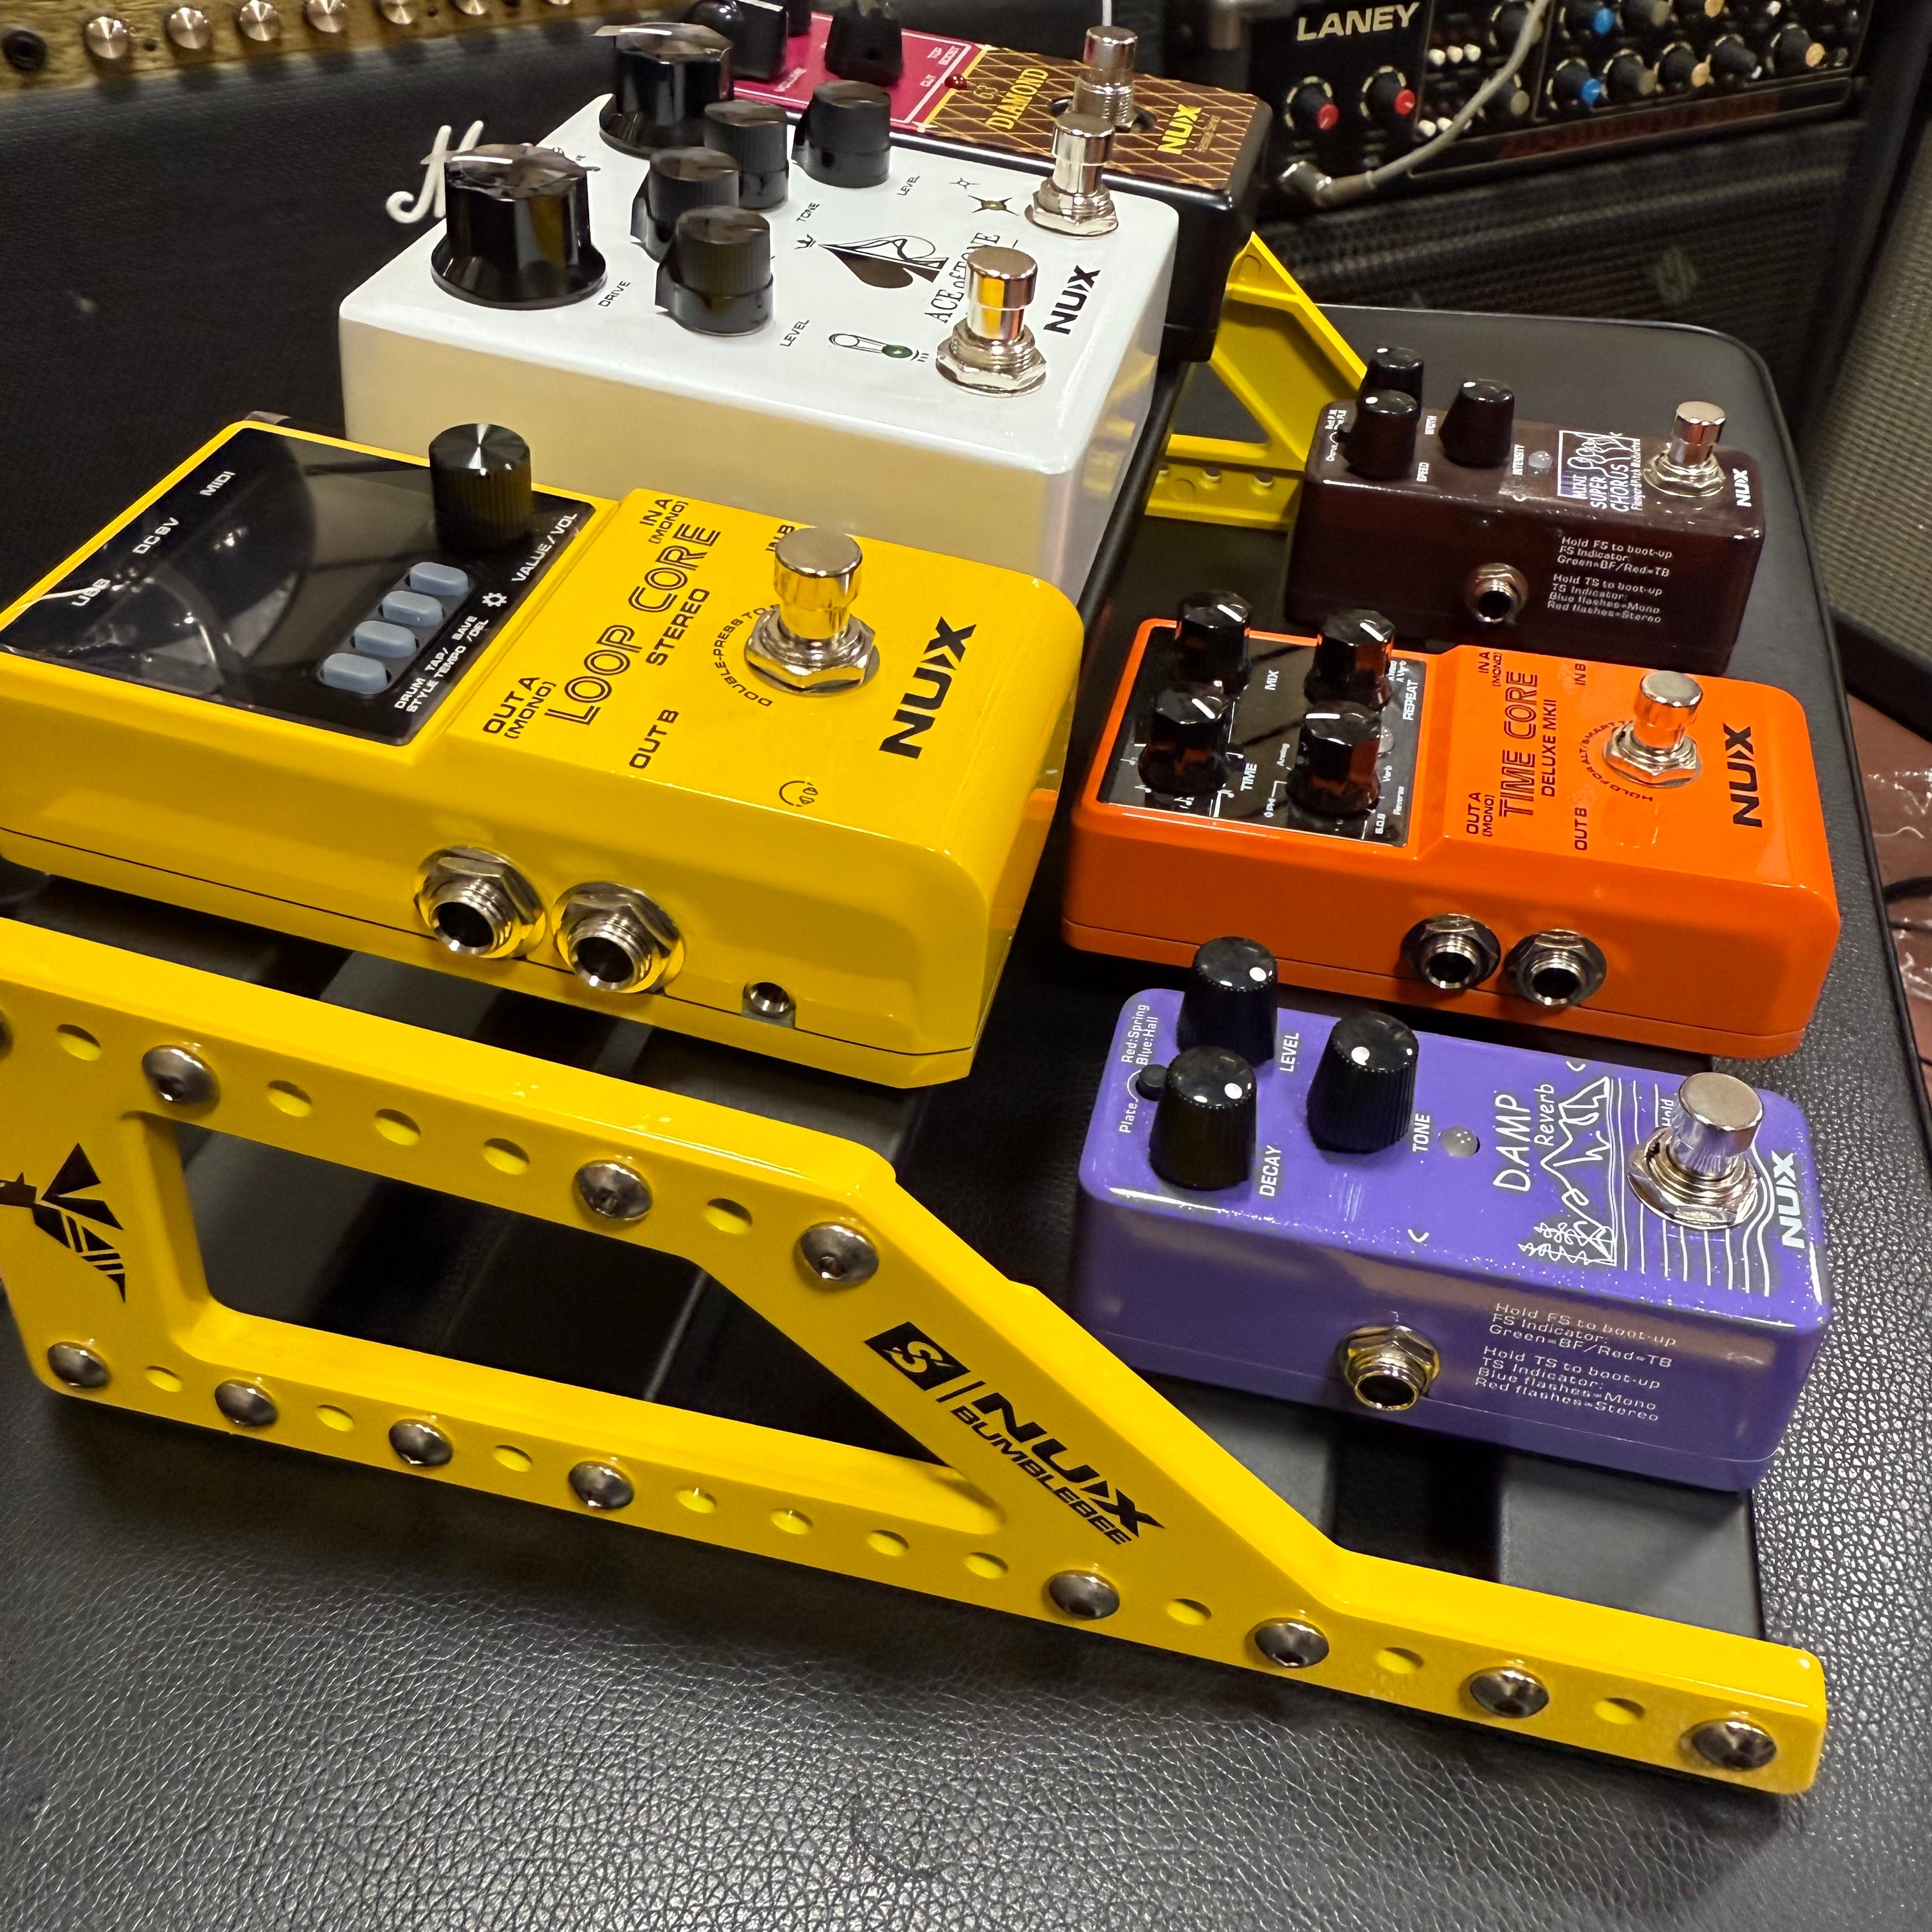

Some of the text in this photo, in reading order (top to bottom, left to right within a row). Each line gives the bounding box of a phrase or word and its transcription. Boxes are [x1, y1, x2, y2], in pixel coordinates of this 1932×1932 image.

[1296, 2, 1420, 41] LANEY
[985, 68, 1048, 129] DIAMOND
[1158, 103, 1202, 155] NUX
[897, 175, 920, 196] LEVEL
[796, 202, 820, 223] TONE
[597, 280, 631, 307] DRIVE
[924, 289, 965, 323] ACE
[1043, 264, 1101, 335] NUX
[780, 319, 810, 347] LEVEL
[199, 471, 236, 496] MIDI
[1572, 475, 1588, 500] MINI
[1590, 477, 1607, 509] SUPER
[1609, 464, 1629, 512] CHORUS
[1733, 468, 1752, 507] NUX
[639, 499, 673, 526] IN A
[648, 500, 689, 544] (MONO)
[132, 535, 160, 554] DC
[511, 543, 552, 581] VALUE
[550, 513, 578, 534] VOL
[1561, 536, 1589, 548] Hold
[1611, 544, 1624, 552] to
[71, 578, 111, 606] USB
[1549, 592, 1574, 602] Blue
[1552, 583, 1567, 592] TS
[1553, 573, 1581, 585] Hold
[1584, 577, 1599, 586] TS
[1602, 581, 1614, 589] to
[544, 523, 721, 726] LOOP CORE
[1547, 601, 1570, 611] Red
[452, 615, 478, 640] SAVE
[645, 588, 710, 666] STEREO
[424, 647, 448, 671] TAP/
[434, 645, 466, 678] TEMPO
[713, 618, 773, 707] DOUBLE-PRESS
[1478, 652, 1491, 674] IN A
[1492, 652, 1502, 687] (MONO)
[1574, 663, 1586, 686] IN B
[394, 677, 426, 709] DRUM
[406, 680, 439, 712] STYLE
[879, 616, 977, 760] NUX
[1264, 670, 1279, 691] MIX
[482, 677, 540, 734] OUT A
[503, 681, 556, 739] (MONO)
[1402, 680, 1418, 721] REPEAT
[629, 709, 679, 769] OUT B
[1499, 671, 1538, 817] TIME CORE
[1541, 699, 1557, 797] DELUXE MKII
[1241, 763, 1257, 791] TIME
[1586, 767, 1610, 785] FOR
[1609, 784, 1653, 801] HOLD
[1722, 723, 1763, 828] NUX
[1466, 792, 1482, 835] OUT A
[1482, 794, 1495, 837] (MONO)
[1574, 807, 1588, 851] OUT B
[1121, 1004, 1150, 1063] Red:Spring
[1136, 1016, 1158, 1066] Blue:Hall
[1279, 1032, 1300, 1072] LEVEL
[1119, 1103, 1138, 1133] Plate
[1412, 1113, 1431, 1153] TONE
[1535, 1084, 1554, 1147] Reverb
[1259, 1145, 1282, 1197] DECAY
[1771, 1151, 1805, 1249] NUX
[1492, 1313, 1608, 1344] FS Indicator:
[1496, 1303, 1676, 1347] Hold FS to boot-up
[1482, 1356, 1604, 1390] TS Indicator:
[1483, 1346, 1660, 1390] Hold TS to boot-up
[1475, 1377, 1659, 1422] Red flashes=Stereo
[1478, 1367, 1656, 1411] Blue flashes=Mono
[950, 1405, 1133, 1545] BUMBLEBEE
[970, 1392, 1166, 1538] NUX
